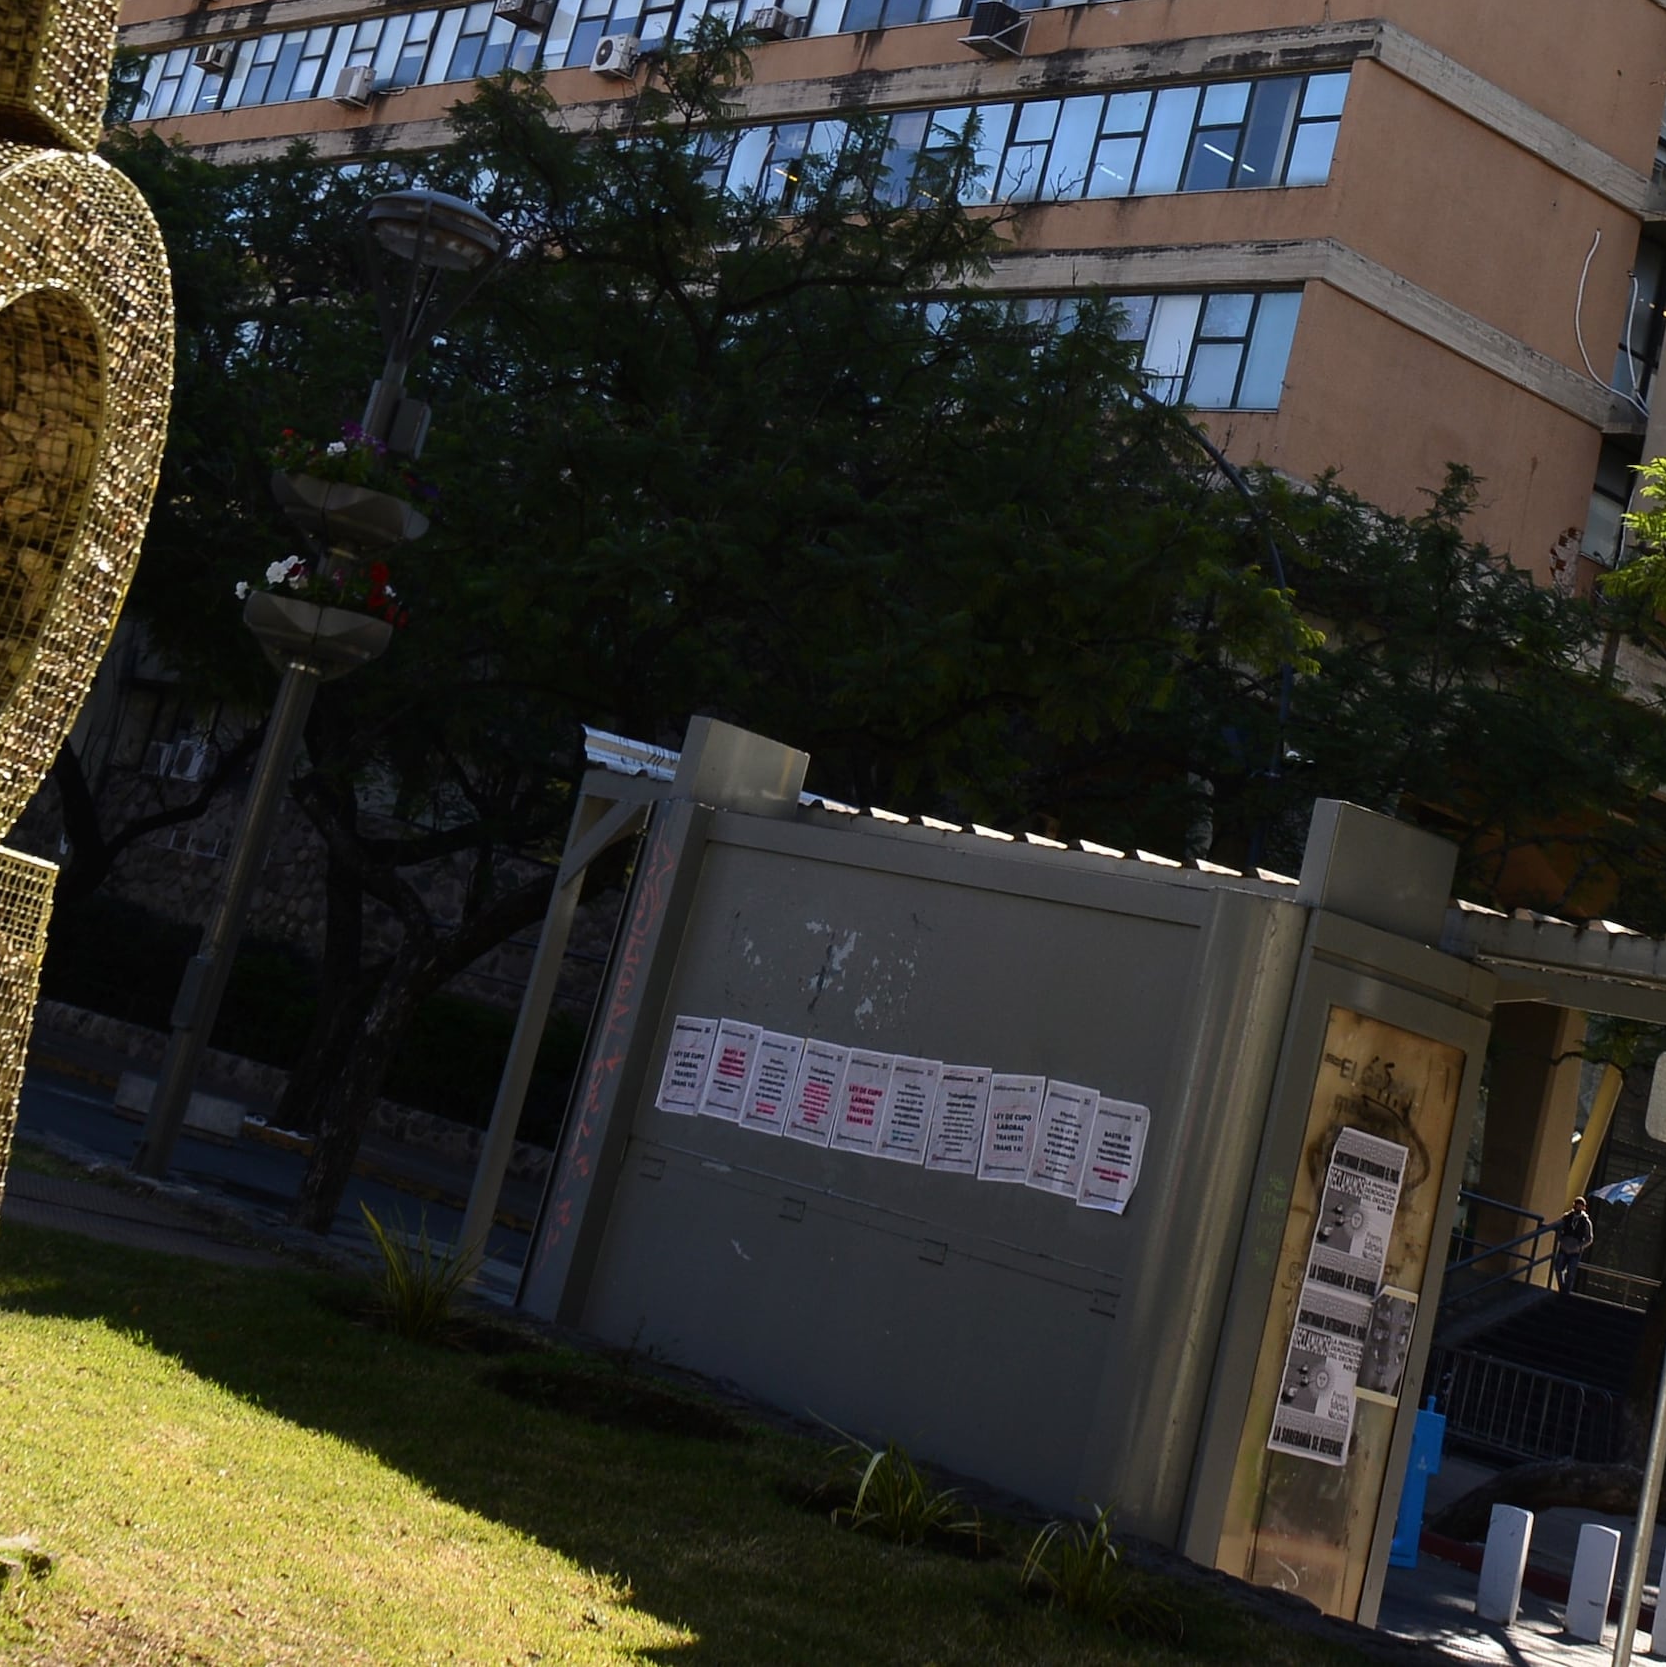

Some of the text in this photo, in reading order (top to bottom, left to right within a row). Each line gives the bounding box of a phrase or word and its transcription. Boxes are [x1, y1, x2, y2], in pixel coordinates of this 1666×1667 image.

[993, 1112, 1005, 1120] LEY
[1014, 1113, 1032, 1122] CUPO
[996, 1123, 1024, 1132] LABORAL
[992, 1143, 1012, 1152] TRANS
